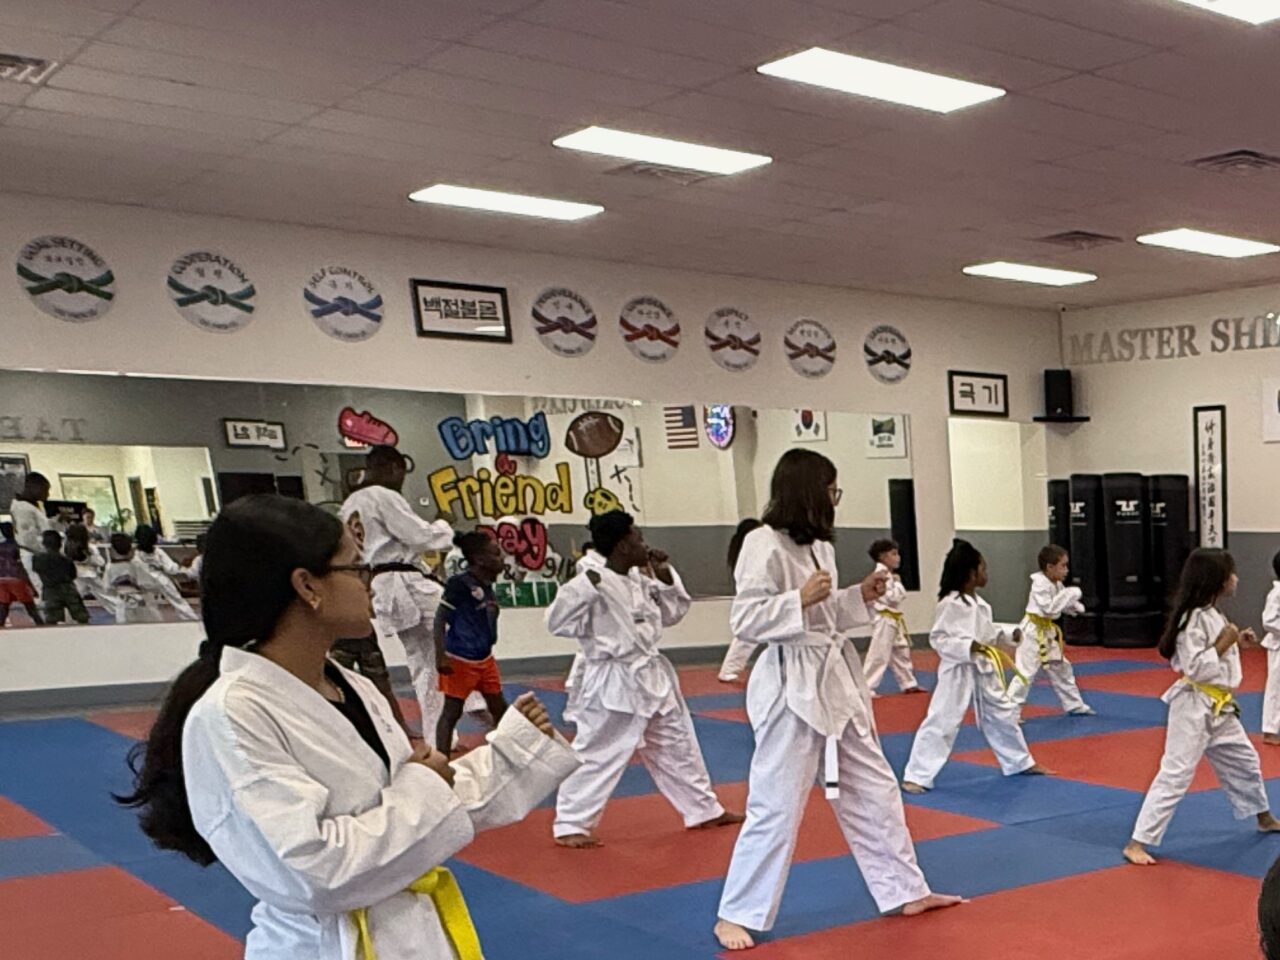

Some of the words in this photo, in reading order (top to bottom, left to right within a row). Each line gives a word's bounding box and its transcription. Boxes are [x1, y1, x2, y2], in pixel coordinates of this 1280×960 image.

[171, 251, 249, 283] COOPERATION
[422, 296, 501, 321] 백절불굴
[1068, 323, 1200, 366] MASTER
[437, 411, 551, 461] Bring
[495, 453, 517, 476] a
[427, 461, 573, 520] Friend
